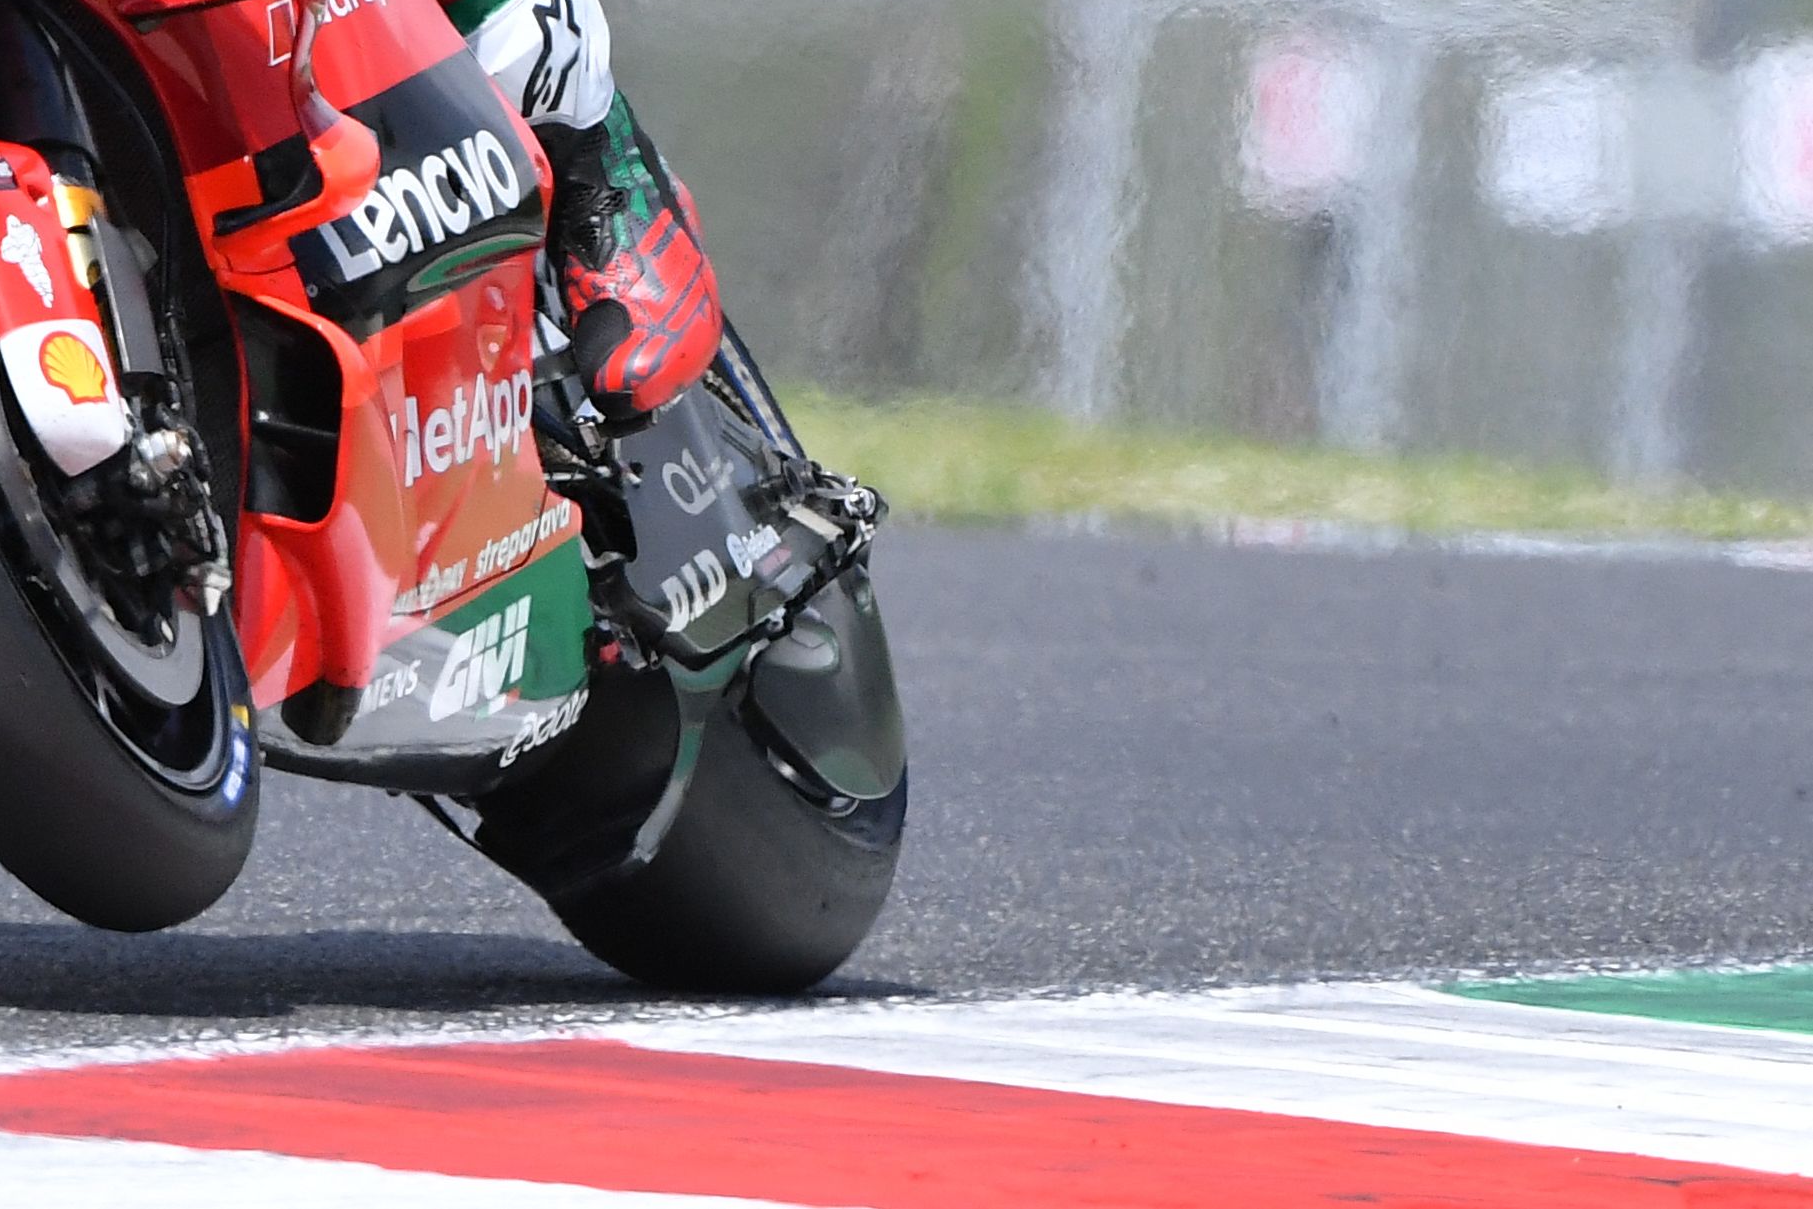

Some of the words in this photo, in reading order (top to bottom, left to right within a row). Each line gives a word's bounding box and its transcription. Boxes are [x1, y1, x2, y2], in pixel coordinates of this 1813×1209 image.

[316, 129, 521, 282] Lenovo
[473, 497, 571, 581] streparava
[429, 594, 532, 723] GIVI
